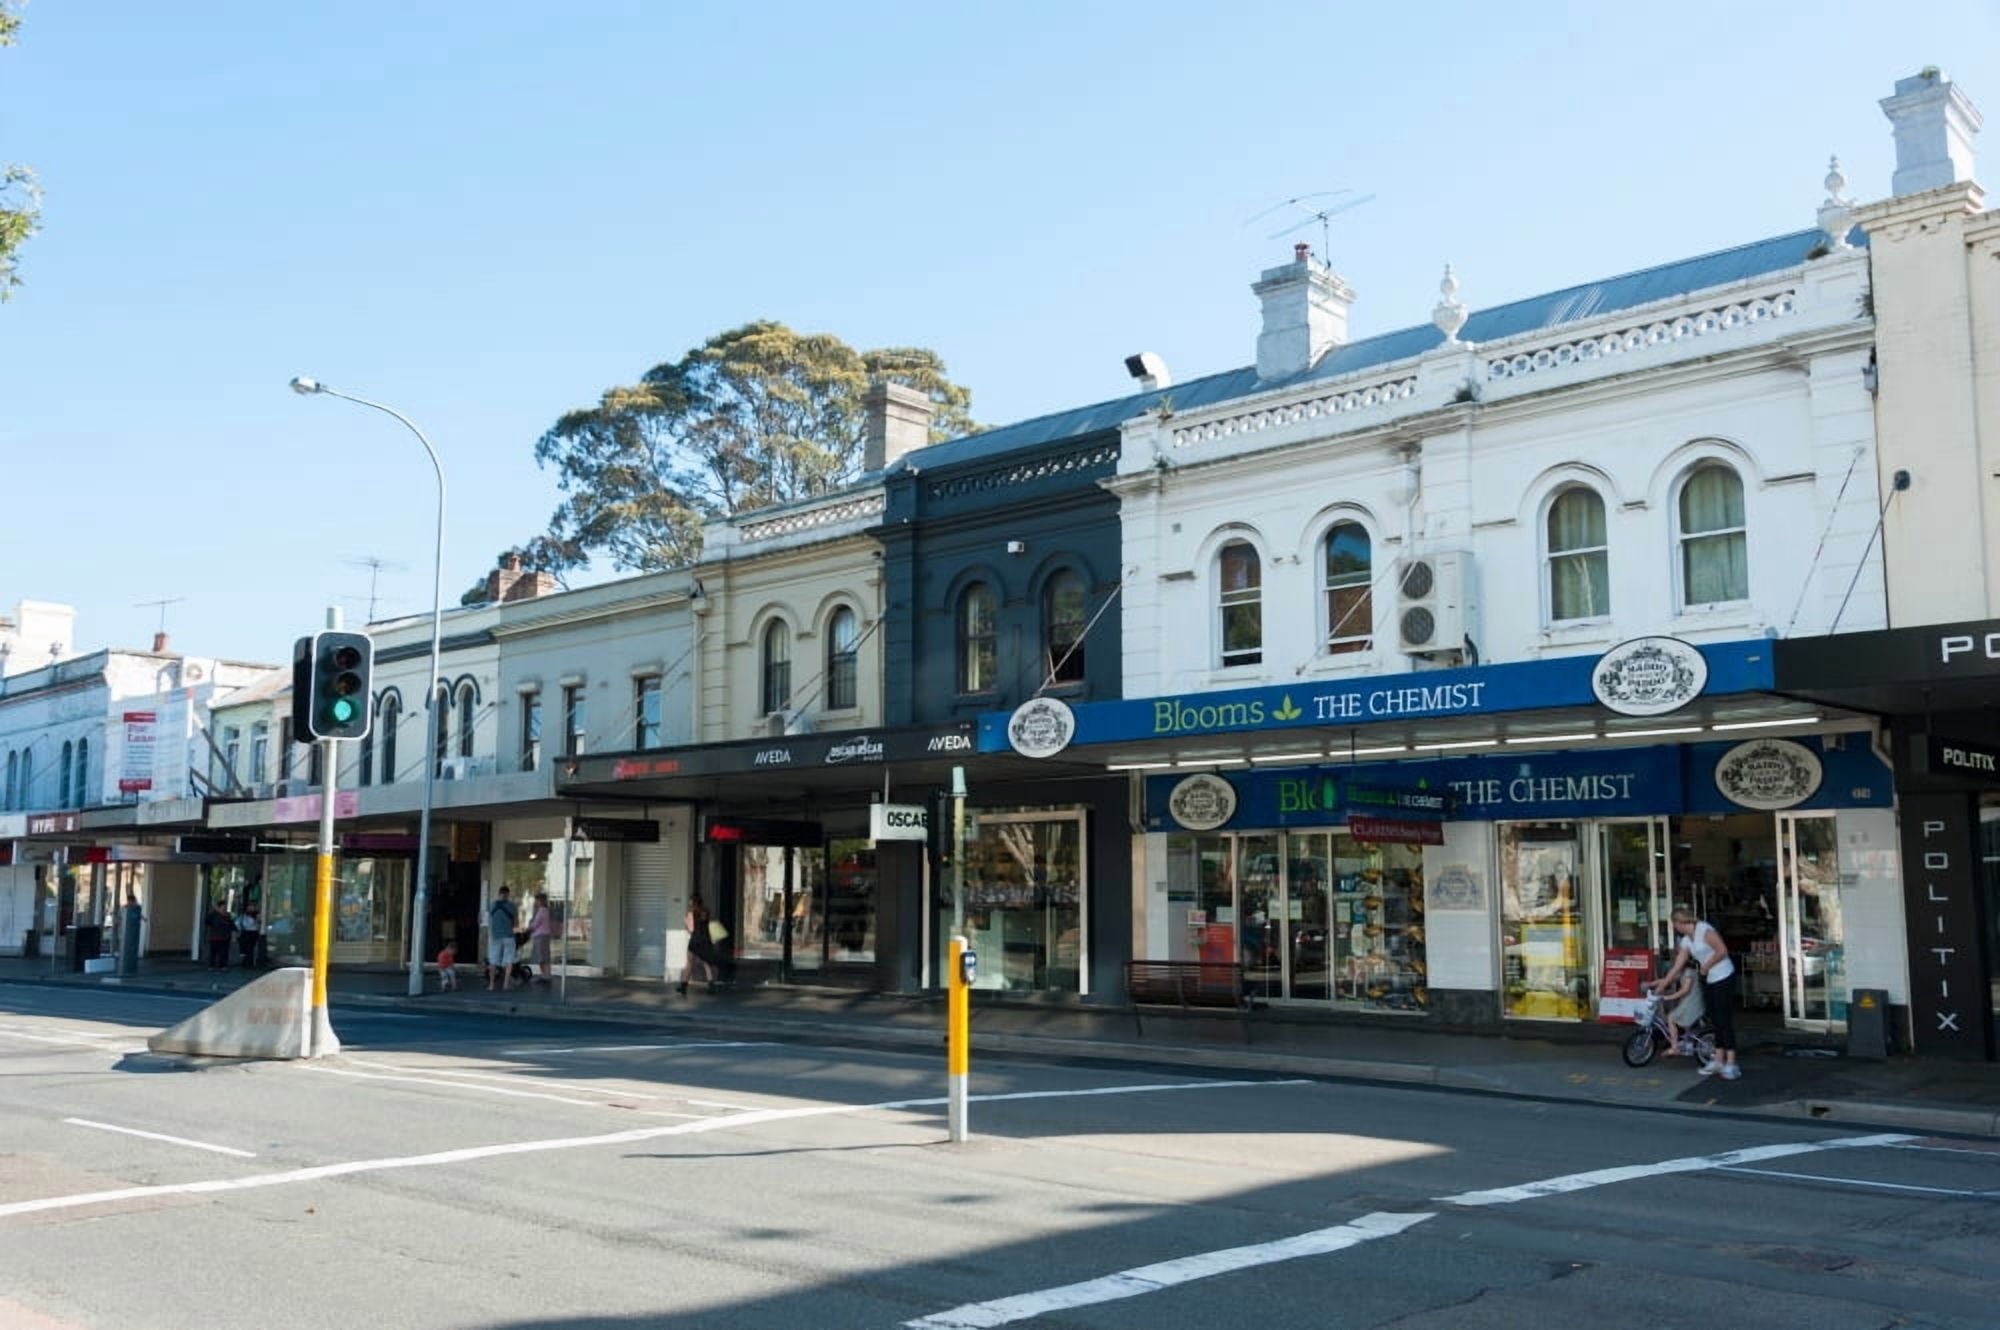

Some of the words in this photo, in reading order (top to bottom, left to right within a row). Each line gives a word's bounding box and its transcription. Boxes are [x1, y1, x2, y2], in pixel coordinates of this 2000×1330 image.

[1153, 700, 1265, 732] Blooms
[1314, 693, 1363, 719] THE
[1369, 682, 1485, 716] CHEMIST
[928, 735, 971, 750] AVEDA
[754, 750, 791, 765] AVEDA
[1943, 748, 1996, 772] POLITIX
[1509, 772, 1635, 803] CHEMIST
[1923, 820, 1960, 1032] POLITIX
